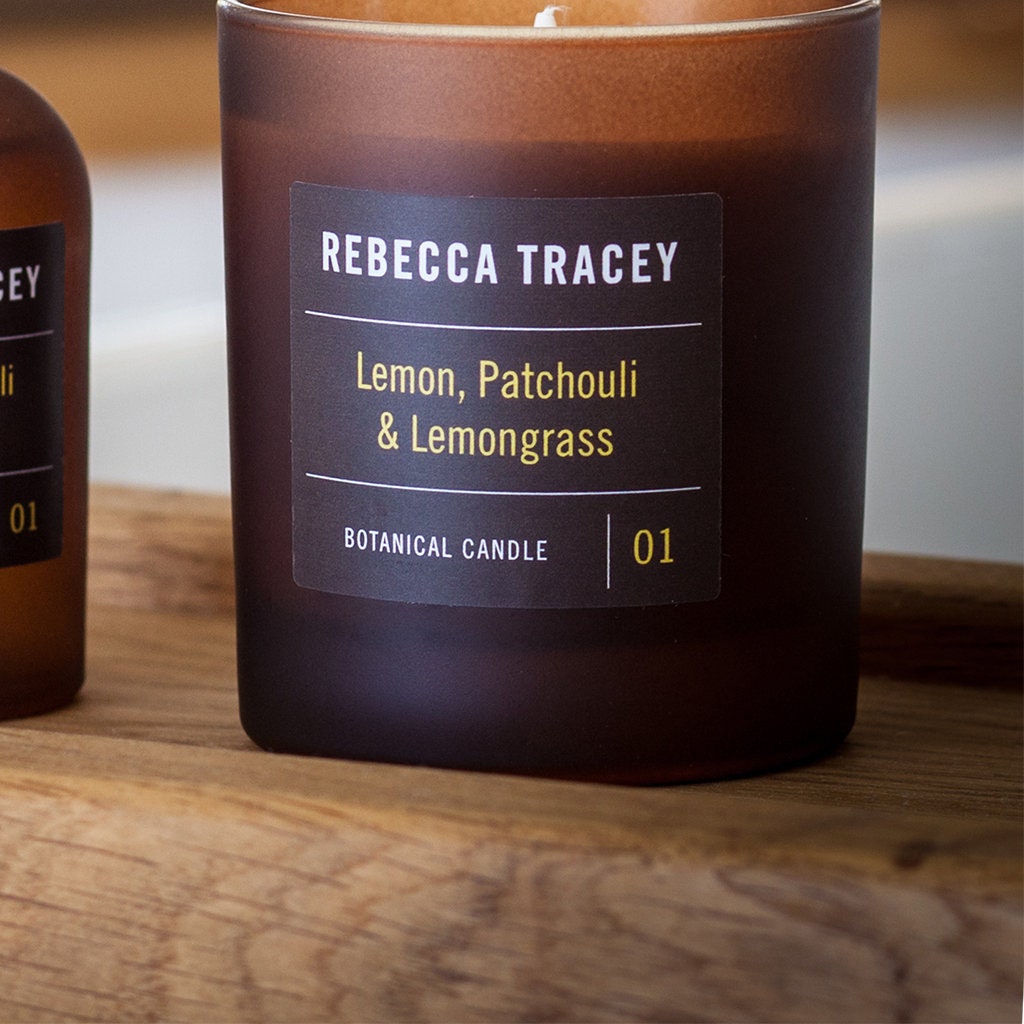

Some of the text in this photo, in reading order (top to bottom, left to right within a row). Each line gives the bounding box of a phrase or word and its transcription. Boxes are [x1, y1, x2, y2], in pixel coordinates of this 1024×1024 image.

[321, 230, 679, 285] REBECCA TRACEY
[356, 351, 637, 405] Lemon, Patchouli
[377, 411, 614, 465] & Lemongrass
[10, 501, 38, 535] 01
[344, 526, 548, 561] BOTANICAL CANDLE
[633, 527, 675, 566] 01
